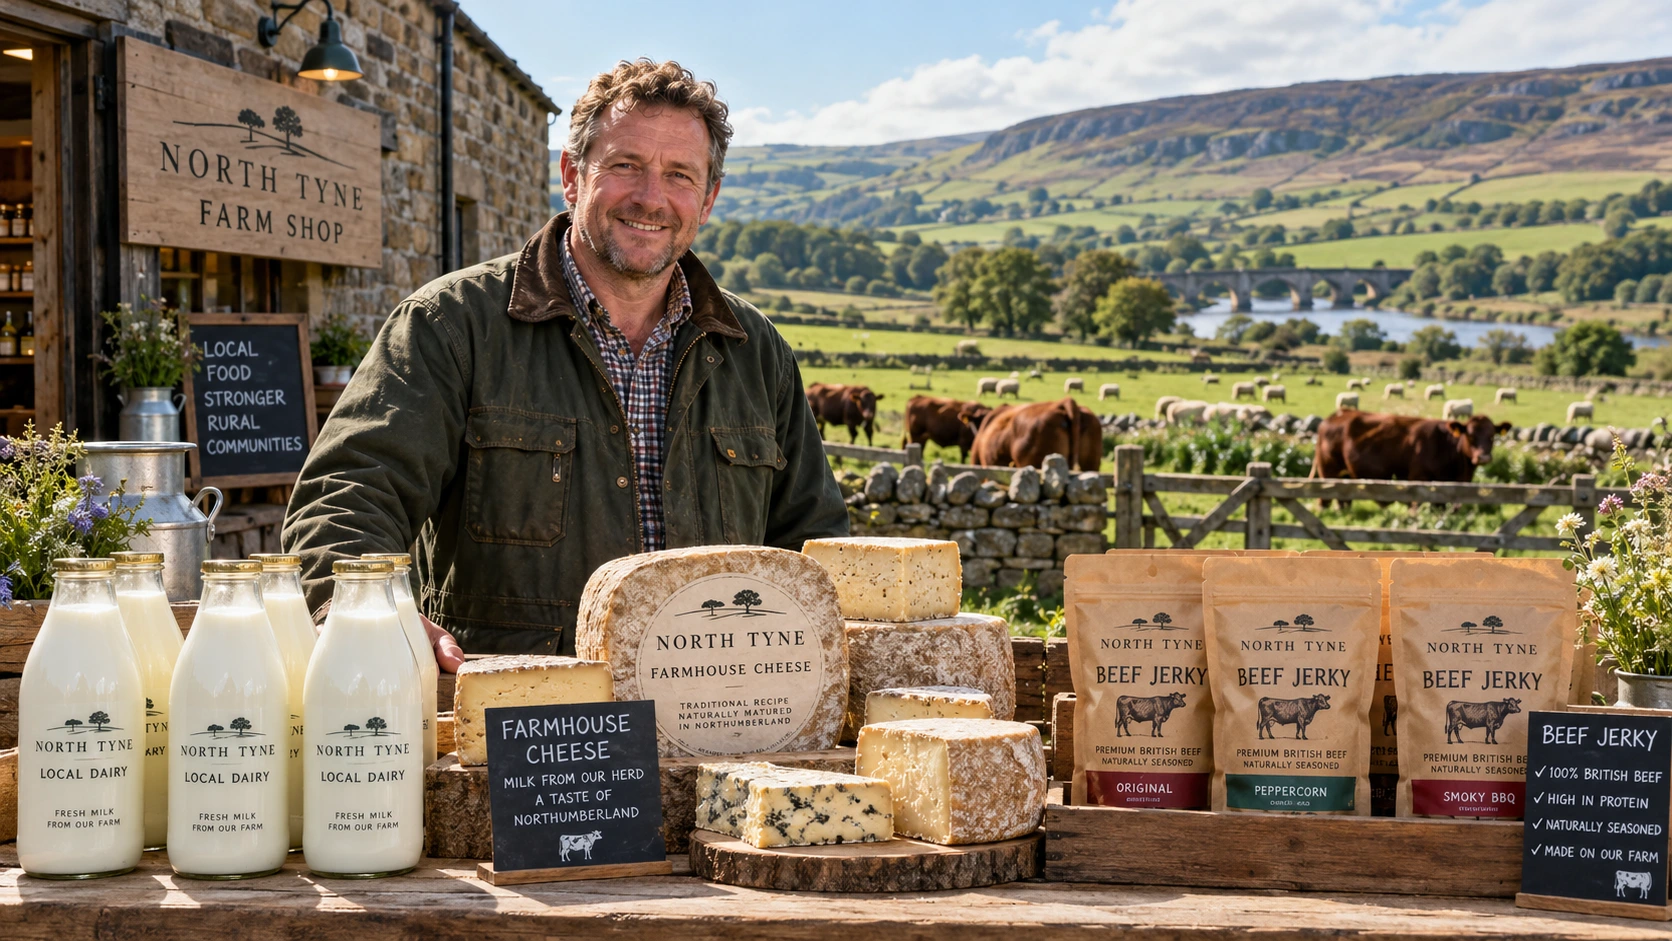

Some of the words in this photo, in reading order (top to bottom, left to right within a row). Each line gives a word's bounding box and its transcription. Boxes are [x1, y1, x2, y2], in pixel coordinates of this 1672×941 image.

[161, 142, 278, 193] NORTH
[296, 173, 362, 211] TYNE
[200, 200, 272, 233] FARM
[287, 214, 345, 245] SHOP
[204, 341, 258, 357] LOCAL
[207, 365, 251, 381] FOOD
[205, 390, 286, 407] STRONGER
[208, 415, 260, 430] RURAL
[207, 436, 302, 454] COMMUNITIES
[656, 633, 735, 651] NORTH
[747, 631, 804, 646] TYNE
[1102, 639, 1152, 649] NORTH
[1163, 639, 1203, 650] TYNE
[1242, 641, 1294, 651] NORTH
[1305, 641, 1345, 651] TYNE
[1428, 643, 1482, 653] NORTH
[1494, 644, 1537, 655] TYNE
[652, 664, 746, 678] FARMHOUSE
[754, 661, 811, 674] CHEESE
[1097, 666, 1141, 683] BEEF
[1150, 666, 1208, 685] JERKY
[1238, 668, 1283, 686] BEEF
[1293, 668, 1350, 687] JERKY
[1423, 670, 1472, 689] BEEF
[1482, 671, 1542, 690] JERKY
[680, 700, 748, 709] TRADITIONAL
[754, 698, 788, 706] RECIPE
[679, 711, 738, 719] NATURALLY
[745, 708, 791, 716] MATURED
[146, 722, 167, 733] TYN
[502, 714, 630, 739] FARMHOUSE
[679, 722, 690, 730] IN
[696, 717, 790, 729] NORTHUMBERLAND
[1542, 725, 1589, 746] BEEF
[1597, 727, 1657, 751] JERKY
[36, 741, 86, 752] NORTH
[97, 739, 132, 751] TYNE
[182, 746, 227, 757] NORTH
[239, 745, 274, 756] TYNE
[317, 745, 363, 756] NORTH
[374, 744, 409, 755] TYNE
[527, 741, 610, 763] CHEESE
[1096, 746, 1135, 754] PREMIUM
[1140, 747, 1177, 755] BRITISH
[1181, 748, 1202, 756] BEEF
[1237, 749, 1278, 757] PREMIUM
[1284, 749, 1322, 758] BRITISH
[1326, 750, 1347, 759] BEEF
[1424, 753, 1467, 762] PREMIUM
[1473, 754, 1512, 763] BRITISH
[1517, 755, 1528, 764] BE
[1151, 758, 1193, 767] SEASONED
[1431, 765, 1481, 773] NATURALLY
[41, 769, 82, 779] LOCAL
[91, 766, 127, 778] DAIRY
[185, 772, 224, 783] LOCAL
[232, 772, 269, 783] DAIRY
[322, 772, 361, 782] LOCAL
[368, 770, 404, 782] DAIRY
[505, 776, 535, 788] MILK
[542, 773, 575, 786] FROM
[582, 771, 605, 783] OUR
[612, 769, 644, 780] HERD
[1550, 767, 1578, 779] 100%
[1585, 768, 1627, 781] BRITISH
[1635, 771, 1662, 783] BEEF
[1117, 783, 1172, 793] ORIGINAL
[1255, 786, 1326, 796] PEPPERCORN
[536, 795, 544, 805] A
[550, 791, 589, 804] TASTE
[596, 789, 612, 802] OF
[1444, 792, 1485, 802] SMOKY
[1492, 793, 1515, 804] BBQ
[1548, 793, 1575, 805] HIGH
[1582, 795, 1593, 805] IN
[1600, 796, 1648, 809] PROTEIN
[515, 807, 639, 826] NORTHUMBERLAND
[193, 824, 214, 832] FROM
[1546, 820, 1603, 832] NATURALLY
[1608, 822, 1661, 835] SEASONED
[1545, 846, 1574, 857] MADE
[1580, 848, 1595, 858] ON
[1601, 849, 1622, 860] OUR
[1629, 850, 1658, 863] FARM
